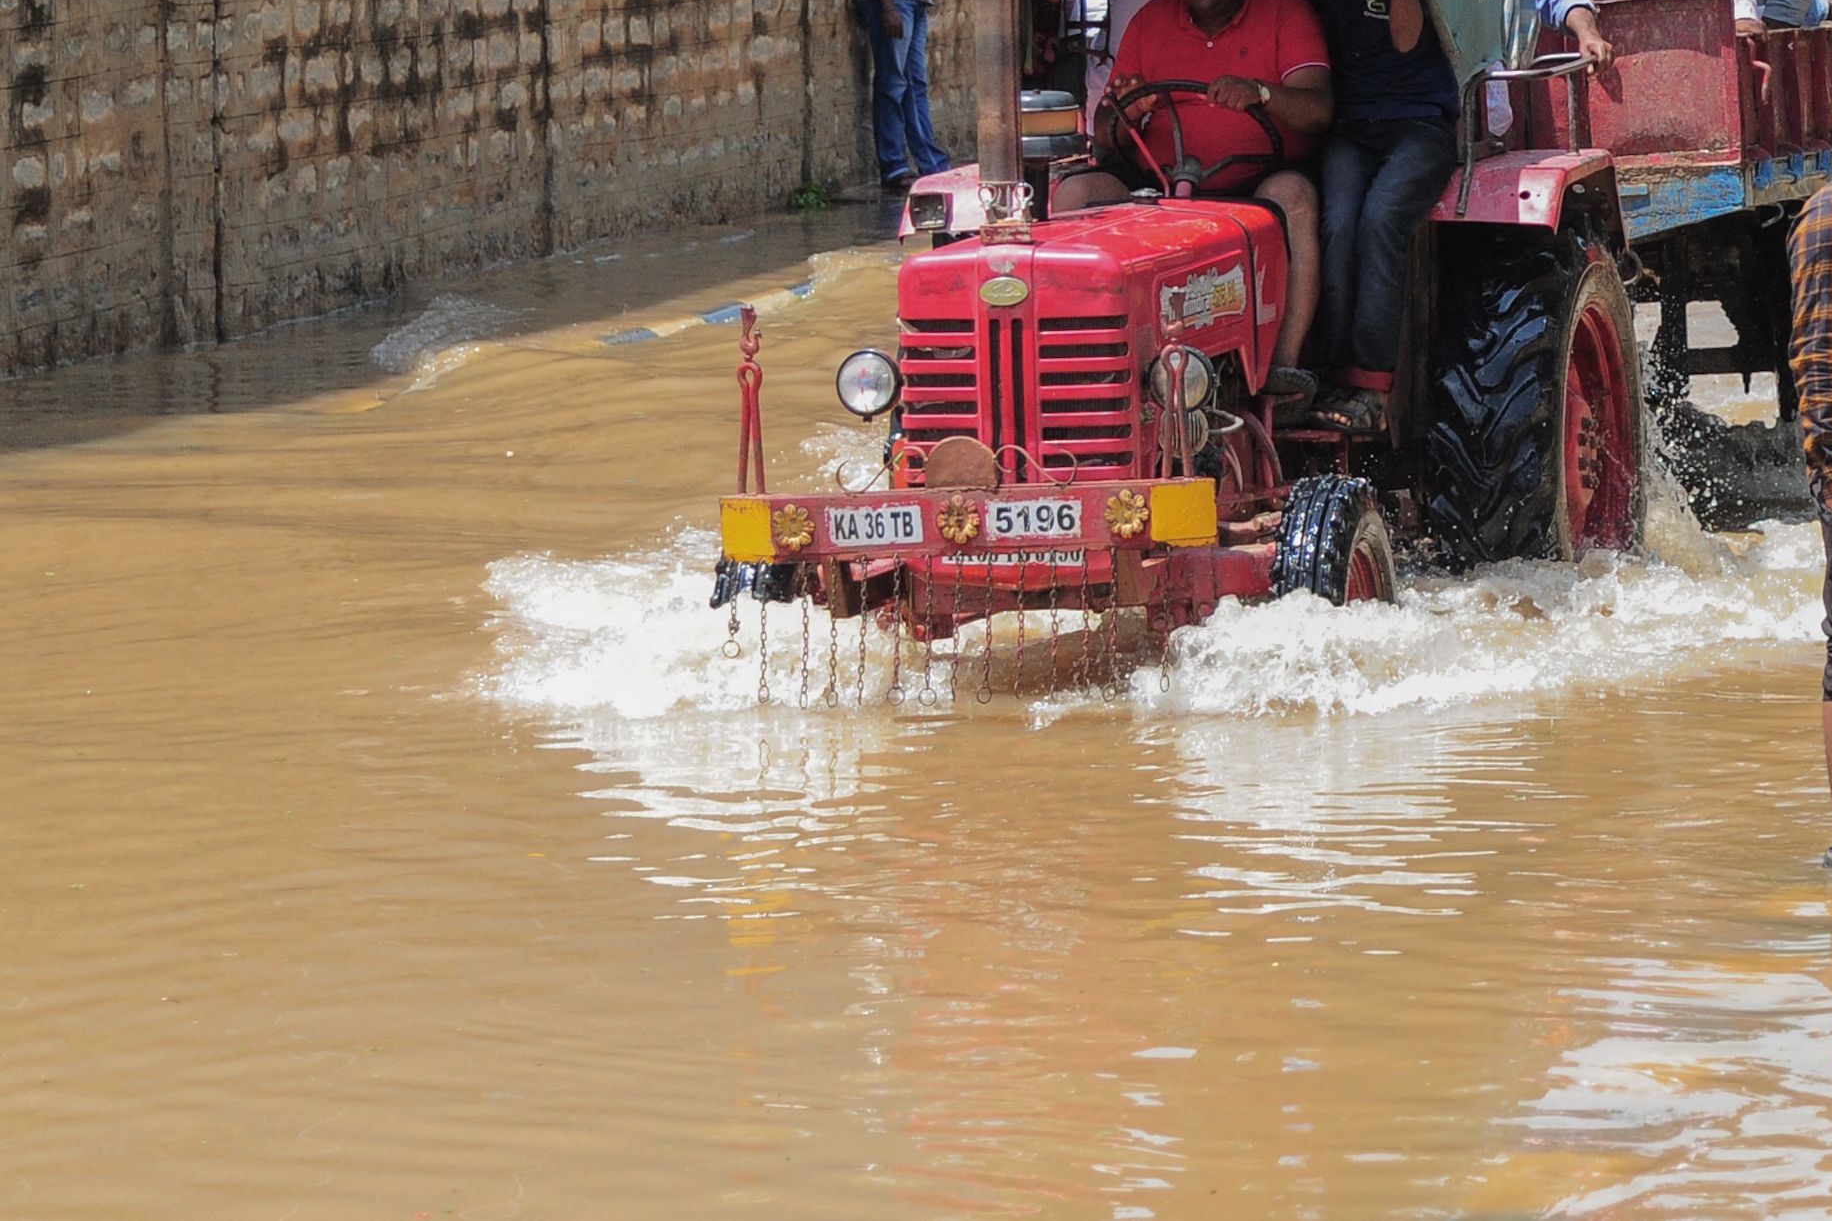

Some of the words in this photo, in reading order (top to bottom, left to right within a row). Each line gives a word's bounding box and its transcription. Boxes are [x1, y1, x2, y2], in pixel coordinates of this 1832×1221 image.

[834, 514, 859, 540] KA
[865, 512, 885, 539] 36
[890, 510, 914, 538] TB
[995, 504, 1076, 534] 5196
